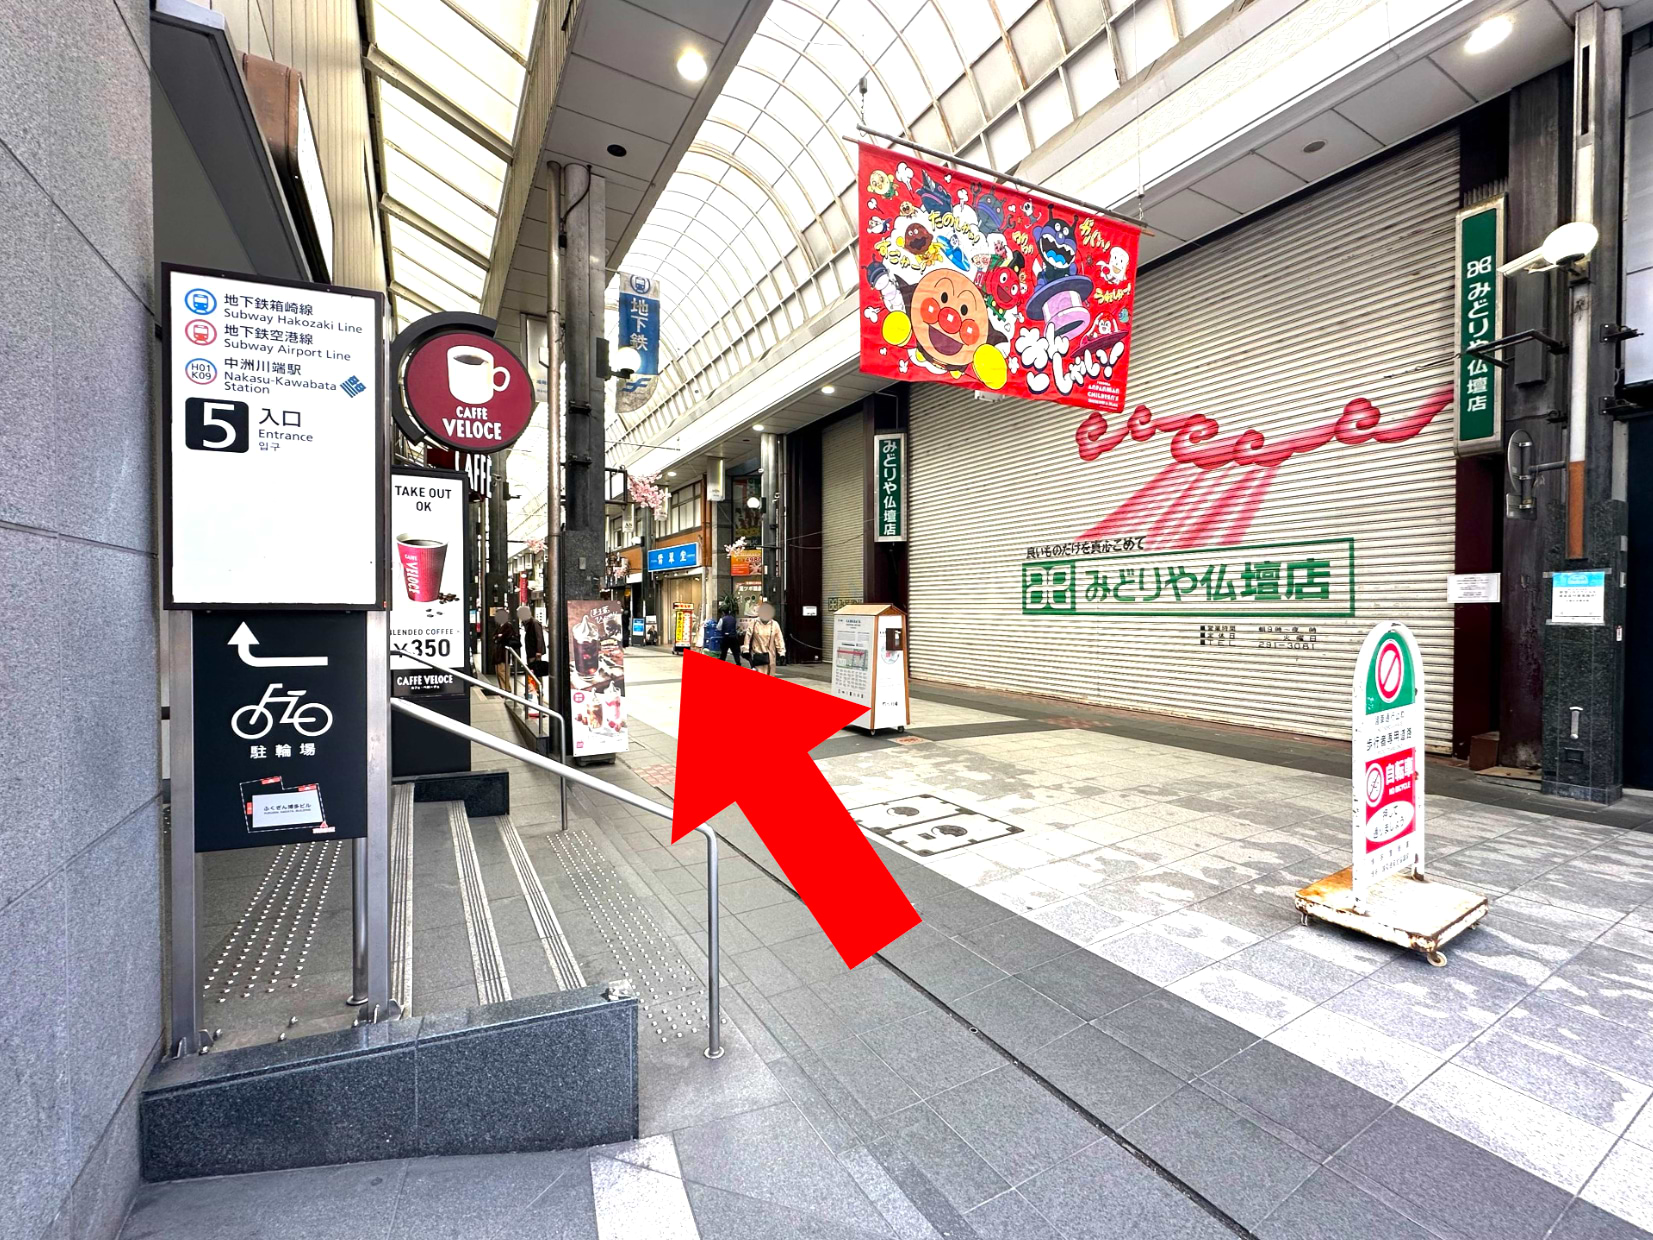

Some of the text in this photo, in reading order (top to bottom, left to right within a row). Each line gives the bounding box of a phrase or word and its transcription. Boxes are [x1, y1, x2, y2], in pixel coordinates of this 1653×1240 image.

[224, 293, 313, 316] 地下鉄箱崎線
[224, 308, 363, 334] Subway Hakozaki Line
[629, 297, 649, 351] 地下鉄
[224, 323, 313, 345] 地下鉄空港線
[224, 338, 351, 362] Subway Airport Line
[1467, 281, 1491, 412] みどり仏壇店
[191, 363, 211, 372] H01
[191, 371, 212, 380] K09
[224, 357, 302, 375] 中洲川端駅
[224, 371, 337, 391] Nakasu-Kawabata
[224, 381, 270, 394] Station
[202, 402, 237, 449] 5
[258, 408, 301, 427] 入口
[258, 429, 314, 442] Entrance
[442, 418, 502, 440] VELOCE
[258, 442, 280, 451] 입구
[395, 485, 452, 499] TAKE OUT
[882, 440, 897, 536] みどりや仏壇店
[416, 502, 432, 511] OK
[405, 561, 421, 594] VELOCE
[1085, 558, 1331, 602] みどりや仏壇店
[423, 674, 454, 685] VELOCE
[250, 743, 316, 759] 駐輪場
[1385, 756, 1414, 785] 自転車
